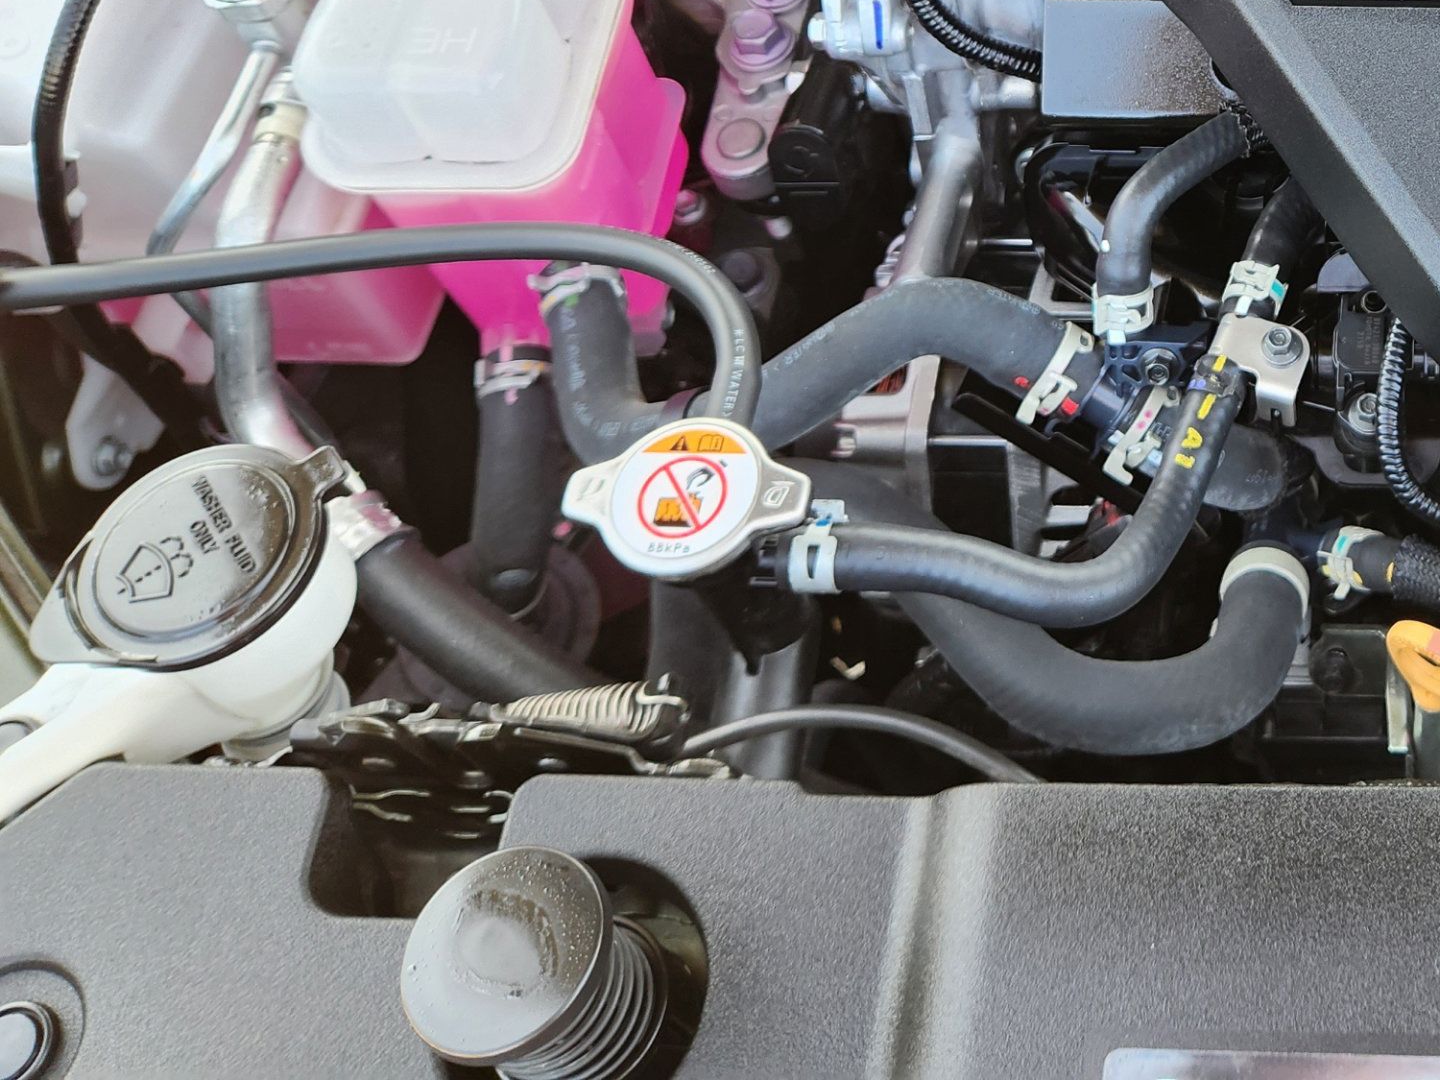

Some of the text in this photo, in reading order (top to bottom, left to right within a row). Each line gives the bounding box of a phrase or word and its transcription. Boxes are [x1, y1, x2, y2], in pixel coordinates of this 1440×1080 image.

[190, 520, 220, 555] ONLY
[192, 475, 257, 574] WASHER FLUID
